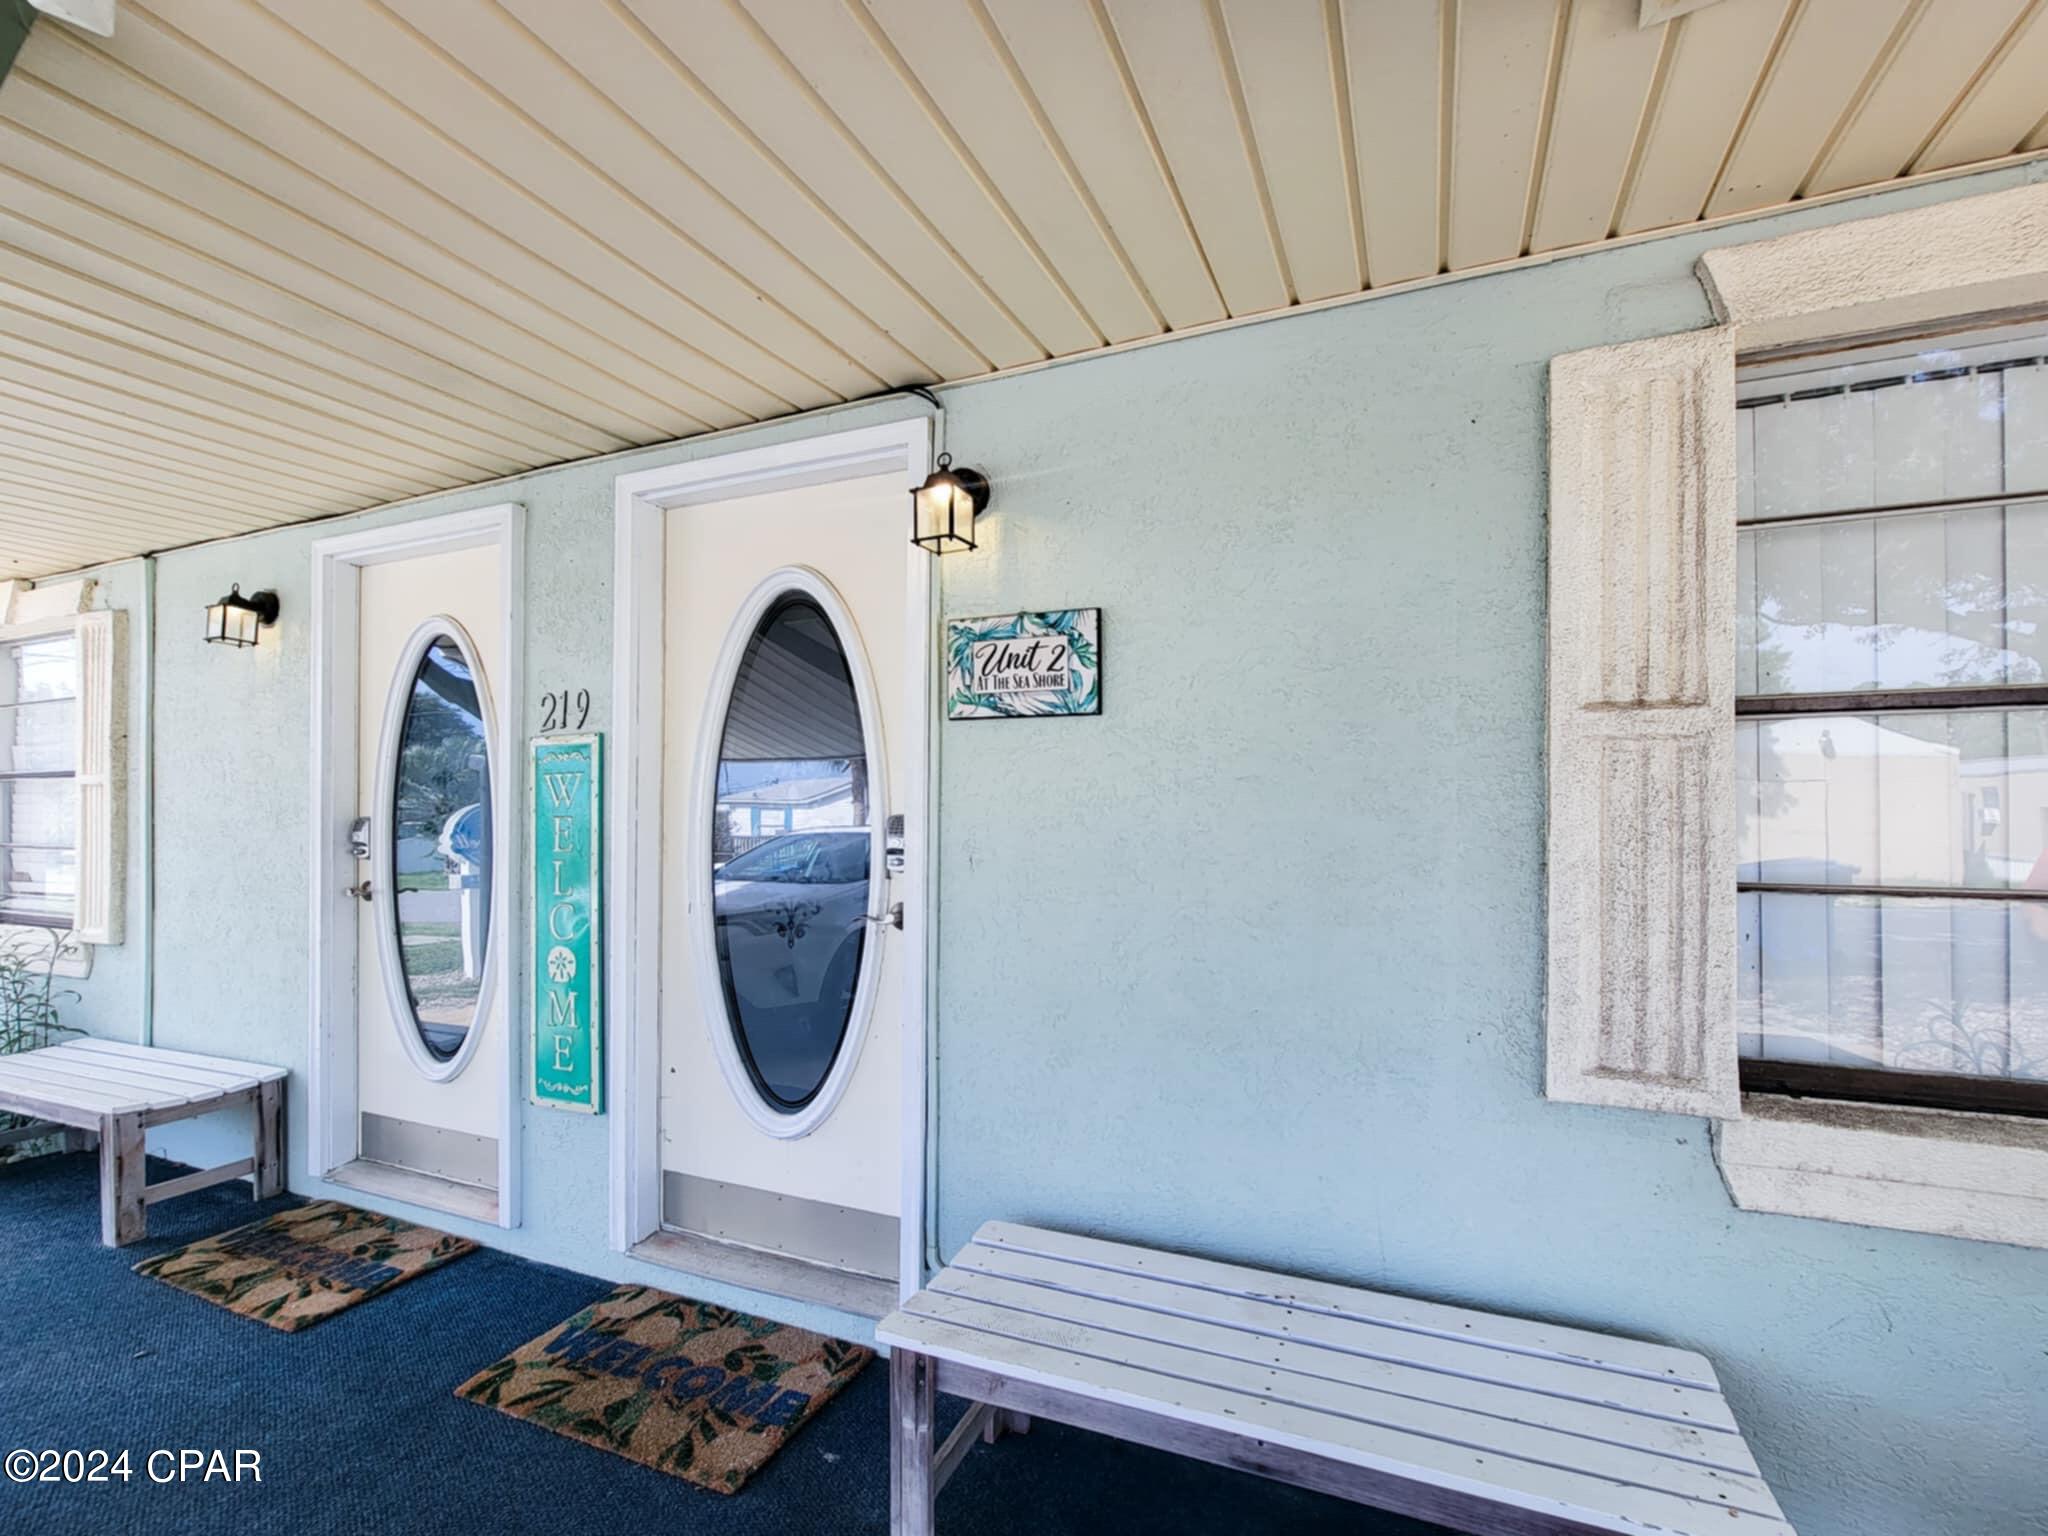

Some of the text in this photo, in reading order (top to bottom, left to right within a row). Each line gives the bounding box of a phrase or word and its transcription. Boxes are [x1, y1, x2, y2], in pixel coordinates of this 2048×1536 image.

[975, 641, 1066, 676] Unit 2
[540, 688, 591, 732] 219
[545, 1328, 811, 1426] WELCOME
